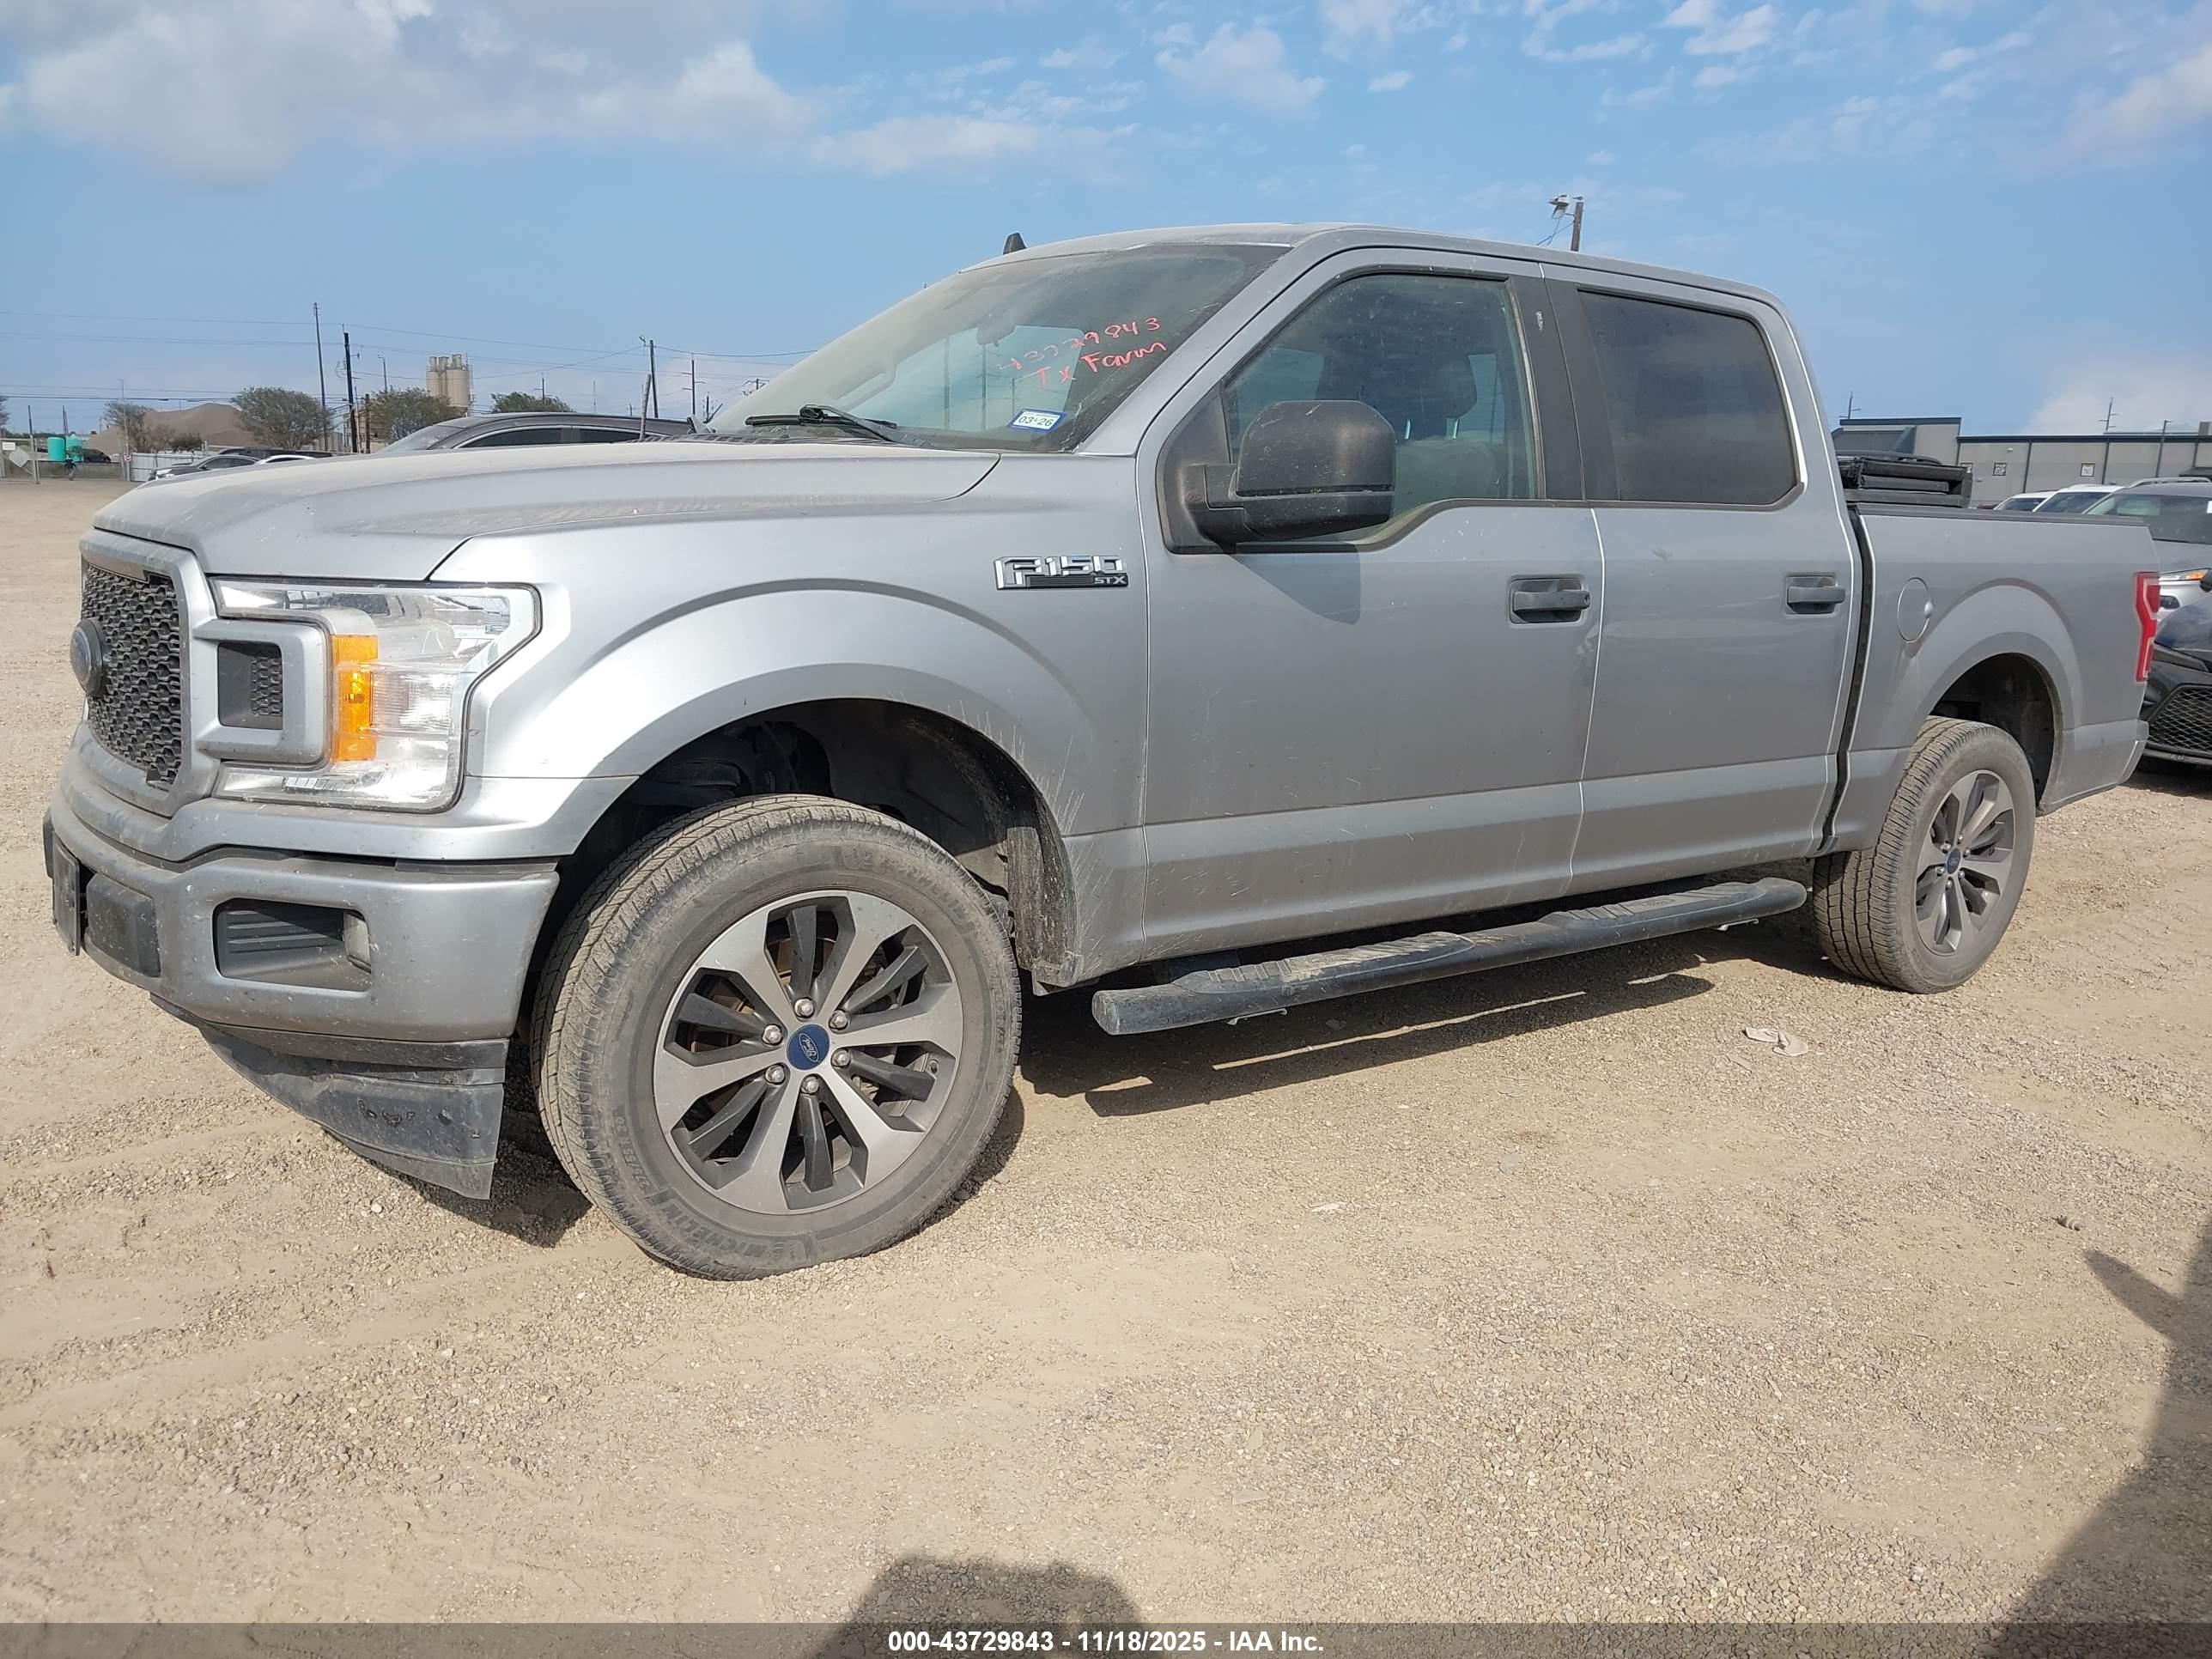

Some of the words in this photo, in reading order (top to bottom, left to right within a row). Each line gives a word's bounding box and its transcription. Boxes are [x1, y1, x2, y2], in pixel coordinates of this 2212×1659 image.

[1081, 342, 1167, 373] Farm
[1093, 575, 1127, 585] STX
[659, 1202, 767, 1258] MICHELIN
